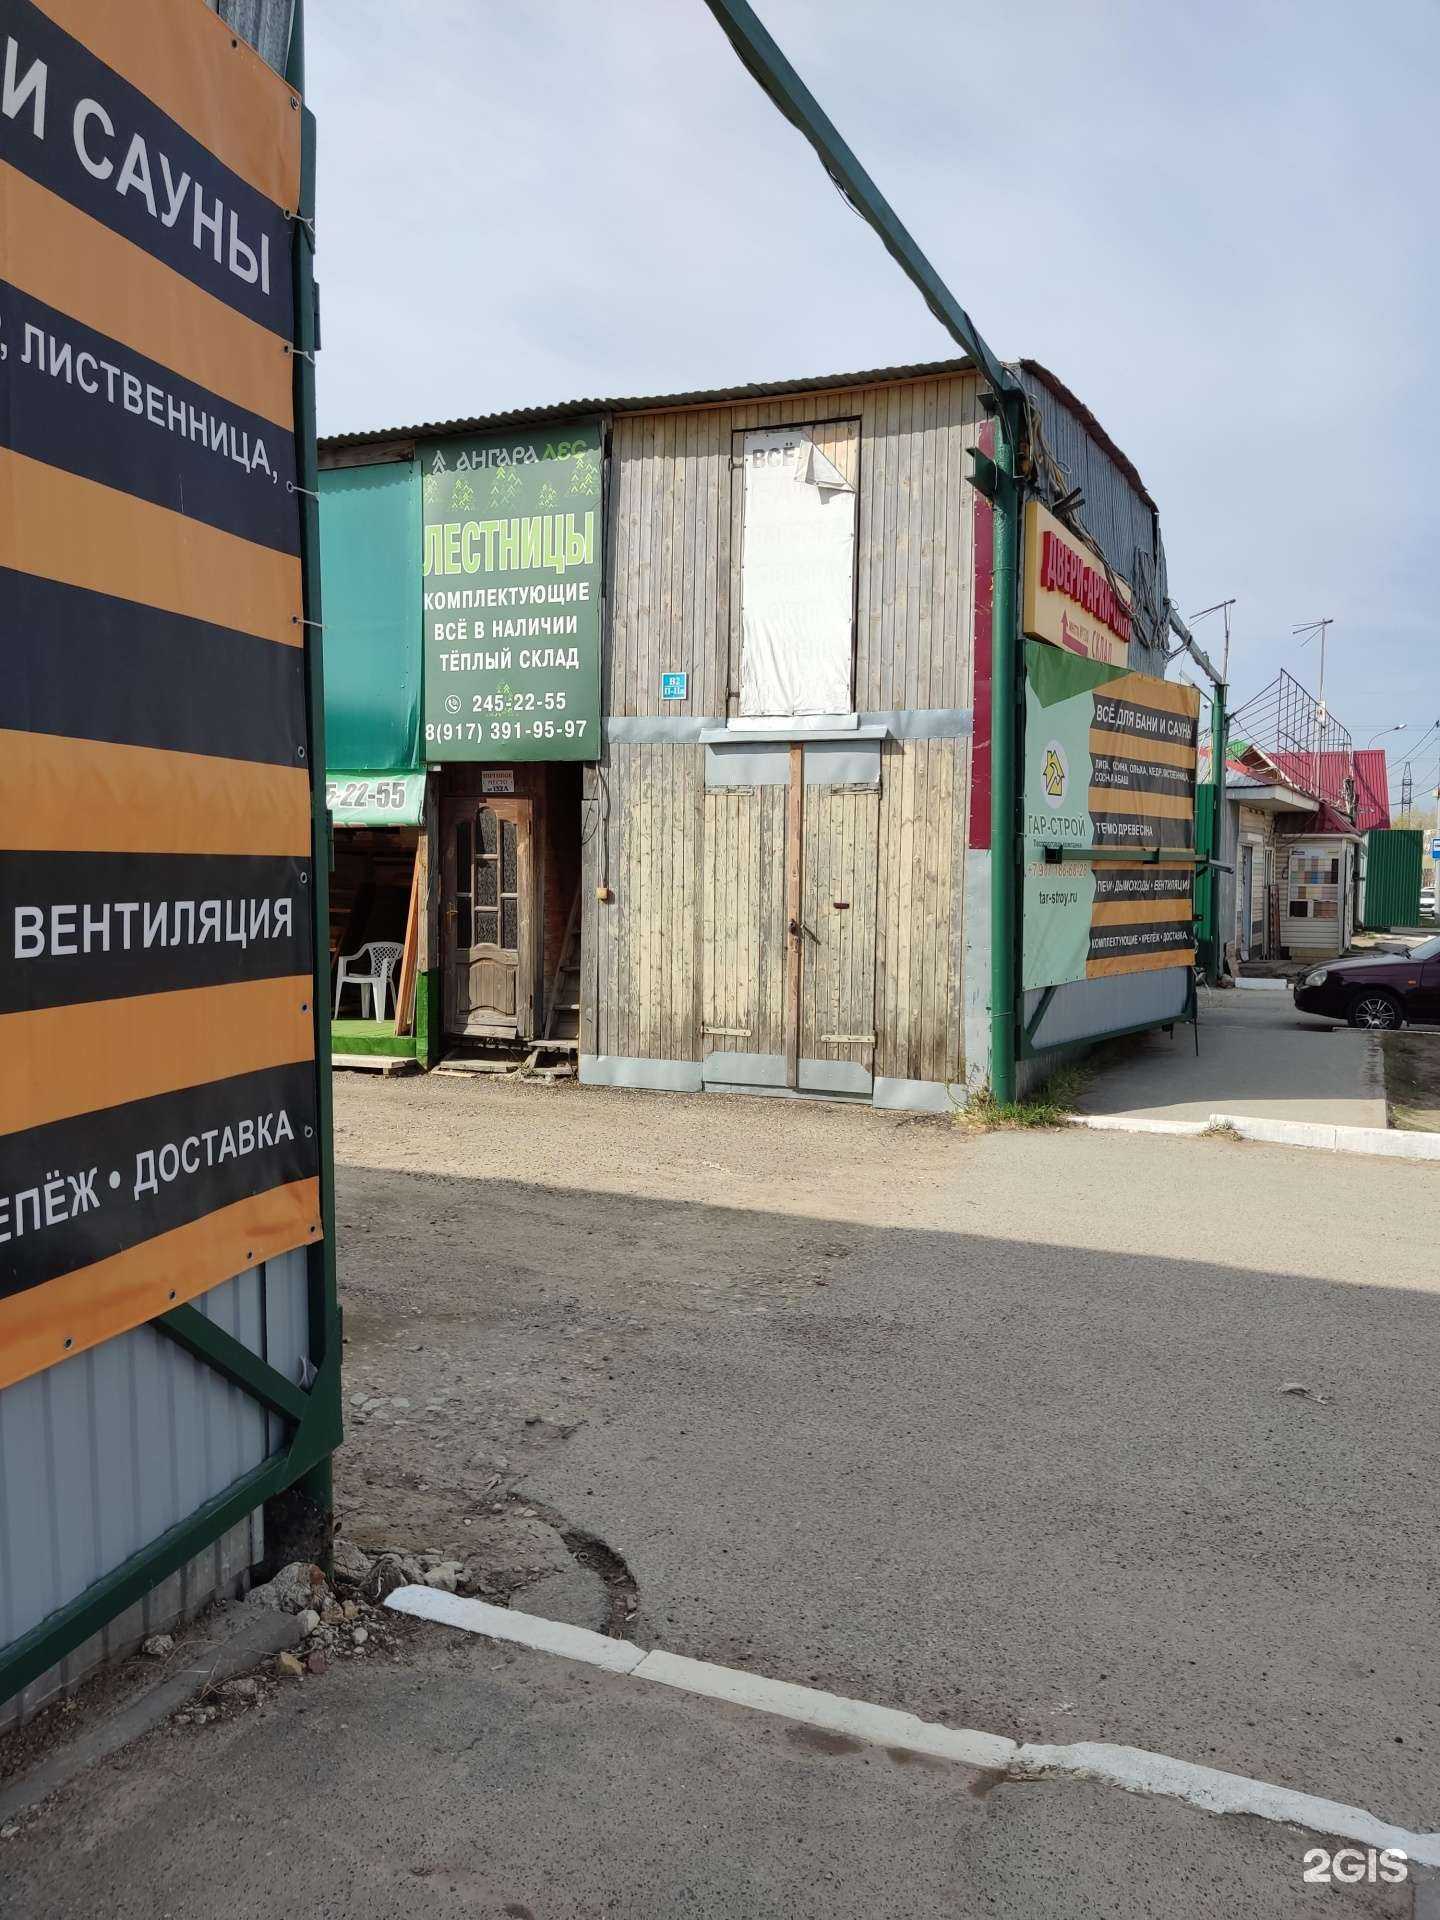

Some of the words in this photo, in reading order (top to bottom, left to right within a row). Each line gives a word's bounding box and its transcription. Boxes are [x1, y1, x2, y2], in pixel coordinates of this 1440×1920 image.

[2, 35, 48, 140] И
[72, 97, 271, 296] САУНЫ
[20, 322, 279, 484] ЛИСТВЕННИЦА,
[456, 446, 539, 471] АНГАРА
[543, 440, 588, 462] ЛЕС
[423, 511, 594, 577] ЛЕСТНИЦЫ
[424, 582, 590, 611] КОМПЛЕКТУЮЩИЕ
[434, 618, 467, 641] ВСЁ
[474, 621, 485, 639] В
[493, 615, 578, 638] НАЛИЧИИ
[440, 647, 512, 672] ТЁПЛЫЙ
[519, 647, 580, 670] СКЛАД
[472, 692, 566, 713] 245-22-55
[425, 722, 483, 744] 8(917)
[490, 720, 588, 740] 391-95-97
[1096, 704, 1115, 724] ВСЁ
[1116, 709, 1134, 728] ДЛЯ
[1135, 712, 1158, 732] БАНИ
[1159, 718, 1166, 734] И
[1039, 890, 1078, 907] tar-stroy.ru
[14, 897, 293, 959] ВЕНТИЛЯЦИЯ
[132, 1109, 295, 1201] ДОСТАВКА
